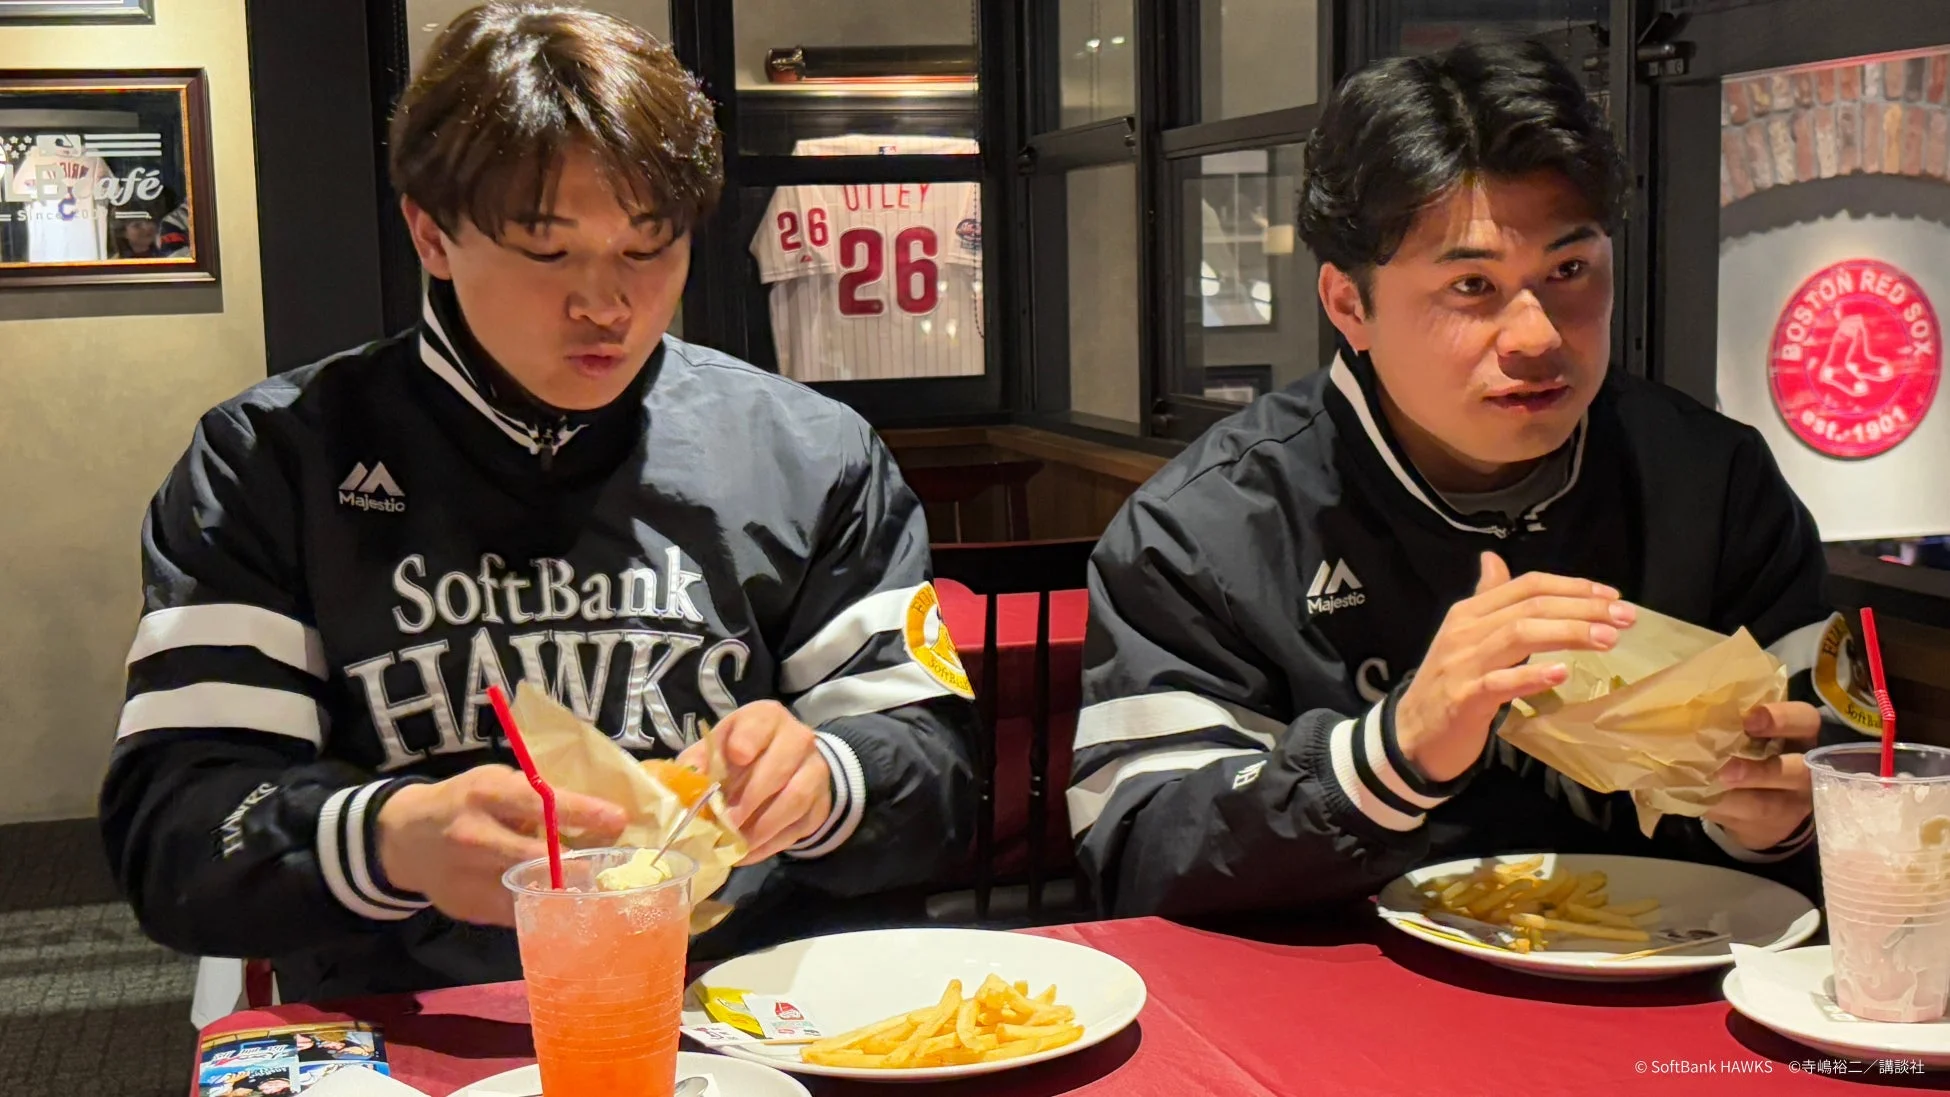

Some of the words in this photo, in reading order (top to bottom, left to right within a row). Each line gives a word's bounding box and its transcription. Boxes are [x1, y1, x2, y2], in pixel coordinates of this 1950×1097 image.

[0, 164, 68, 203] LB
[777, 207, 829, 251] 26
[838, 226, 939, 316] 26
[1781, 268, 1854, 362] BOSTON
[1859, 269, 1907, 305] RED
[1903, 301, 1934, 358] SOX
[1848, 406, 1907, 443] 1901
[338, 490, 406, 514] Majestic
[391, 545, 705, 635] SoftBank
[1306, 591, 1366, 615] Majestic
